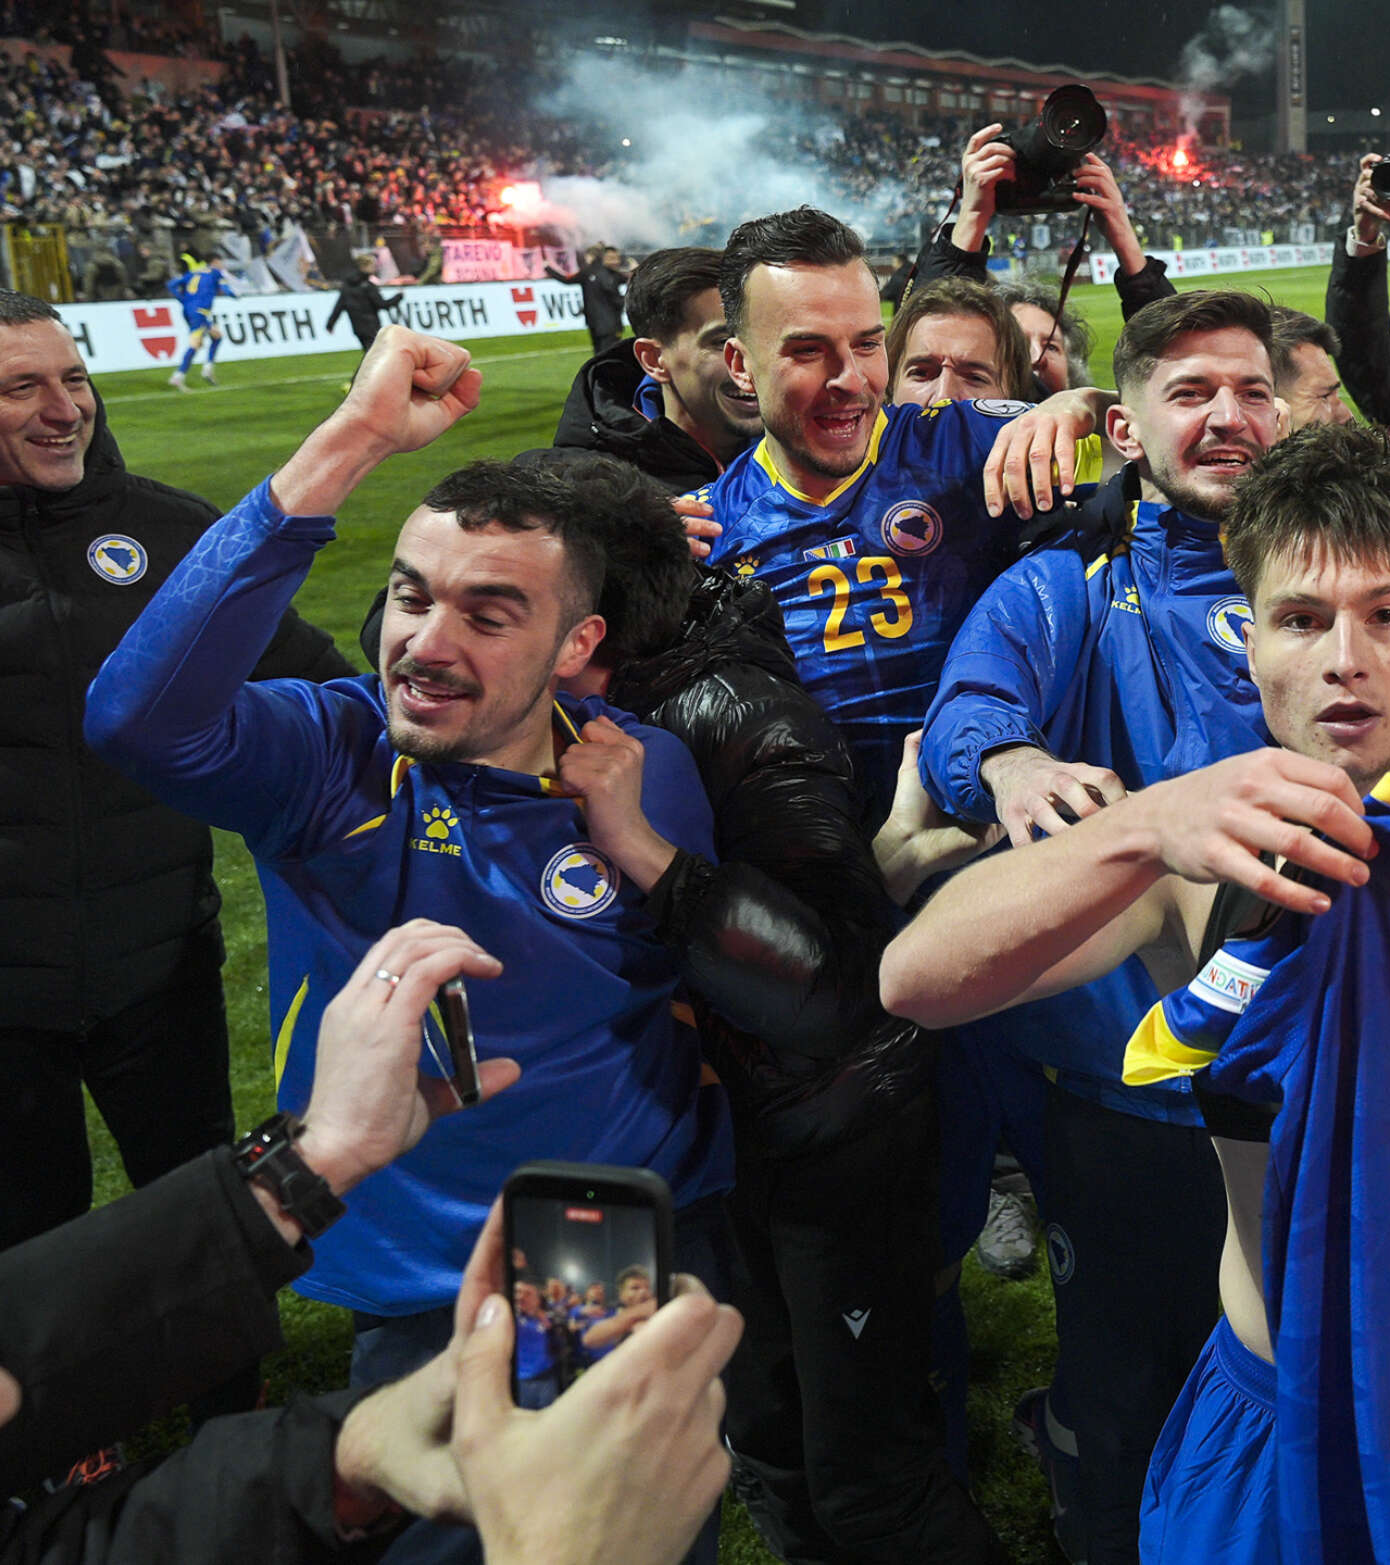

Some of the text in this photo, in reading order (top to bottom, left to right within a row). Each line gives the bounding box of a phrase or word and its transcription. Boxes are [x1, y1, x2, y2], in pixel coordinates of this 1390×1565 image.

[387, 299, 488, 329] WÜRTH
[808, 556, 913, 653] 23
[409, 838, 462, 857] KELME
